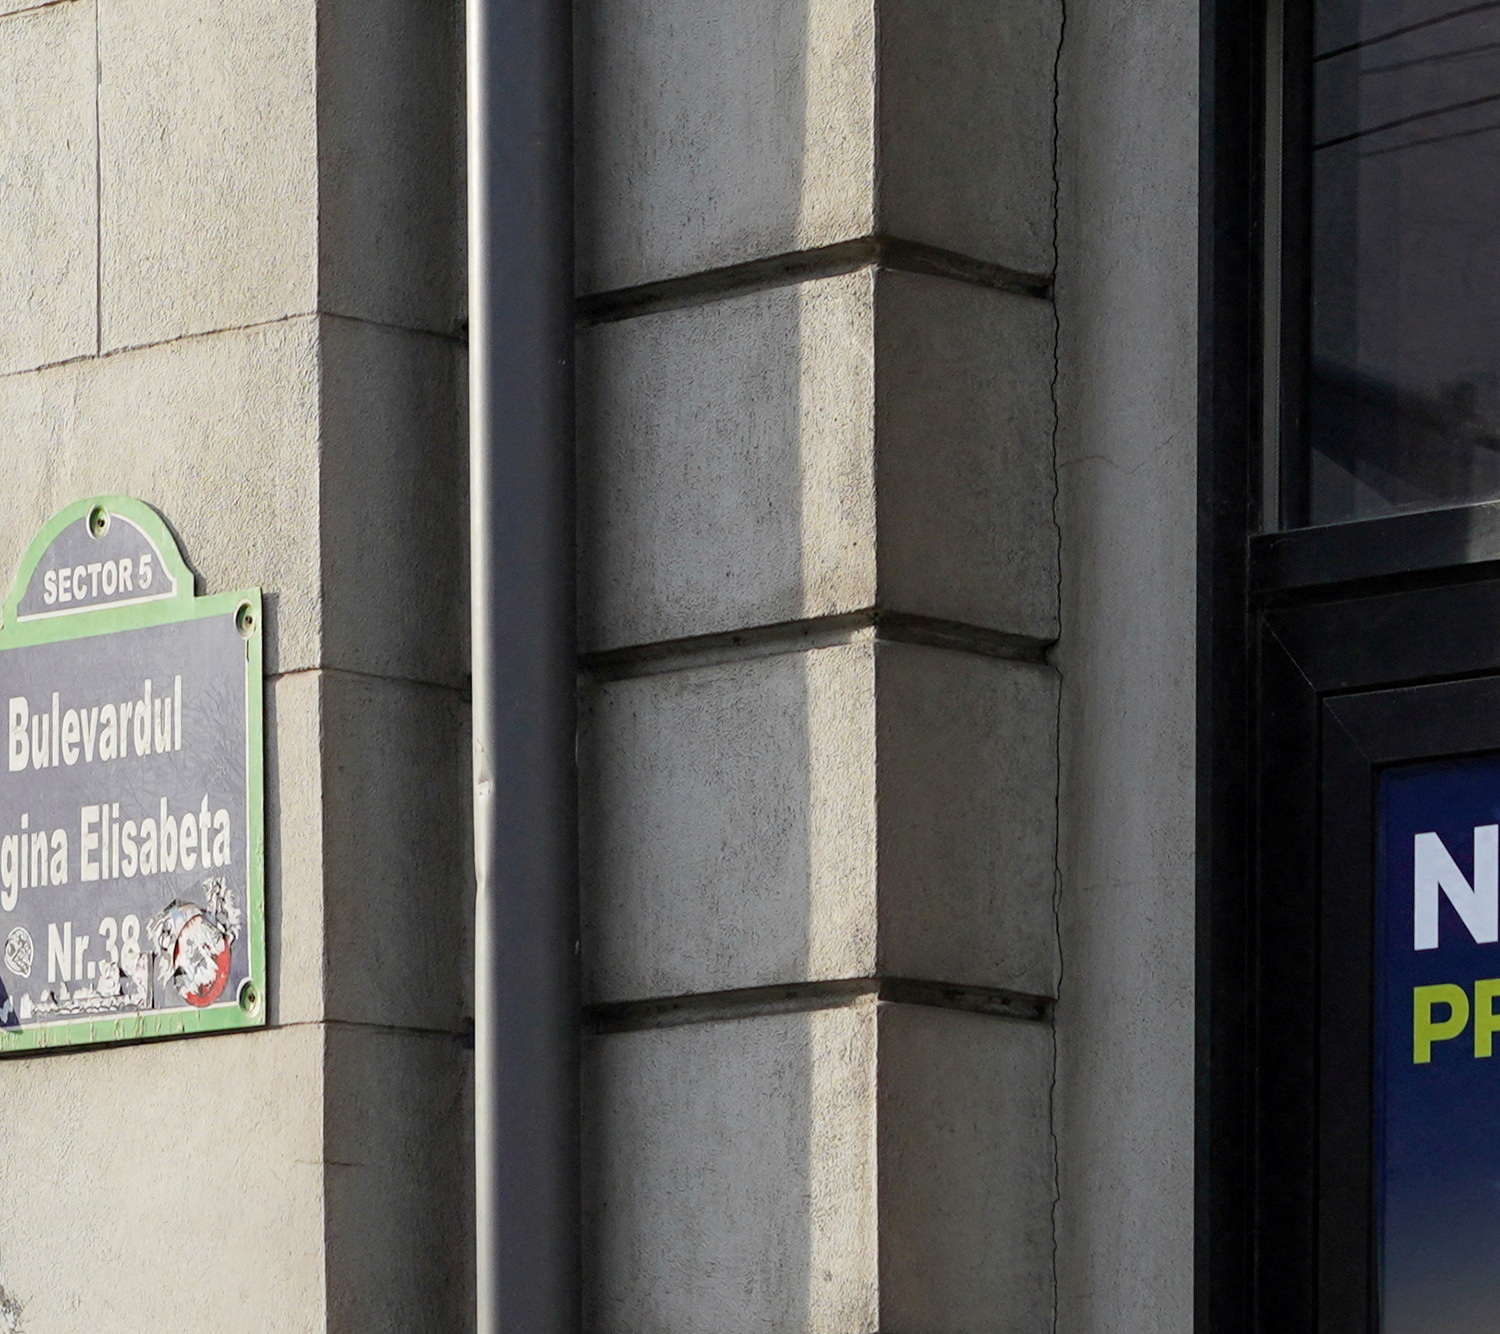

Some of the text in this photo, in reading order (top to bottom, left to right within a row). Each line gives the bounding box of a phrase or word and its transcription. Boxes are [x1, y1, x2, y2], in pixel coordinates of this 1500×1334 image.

[43, 554, 153, 606] SECTOR 5
[8, 675, 182, 772] Bulevardul
[80, 793, 231, 882] Elisabeta
